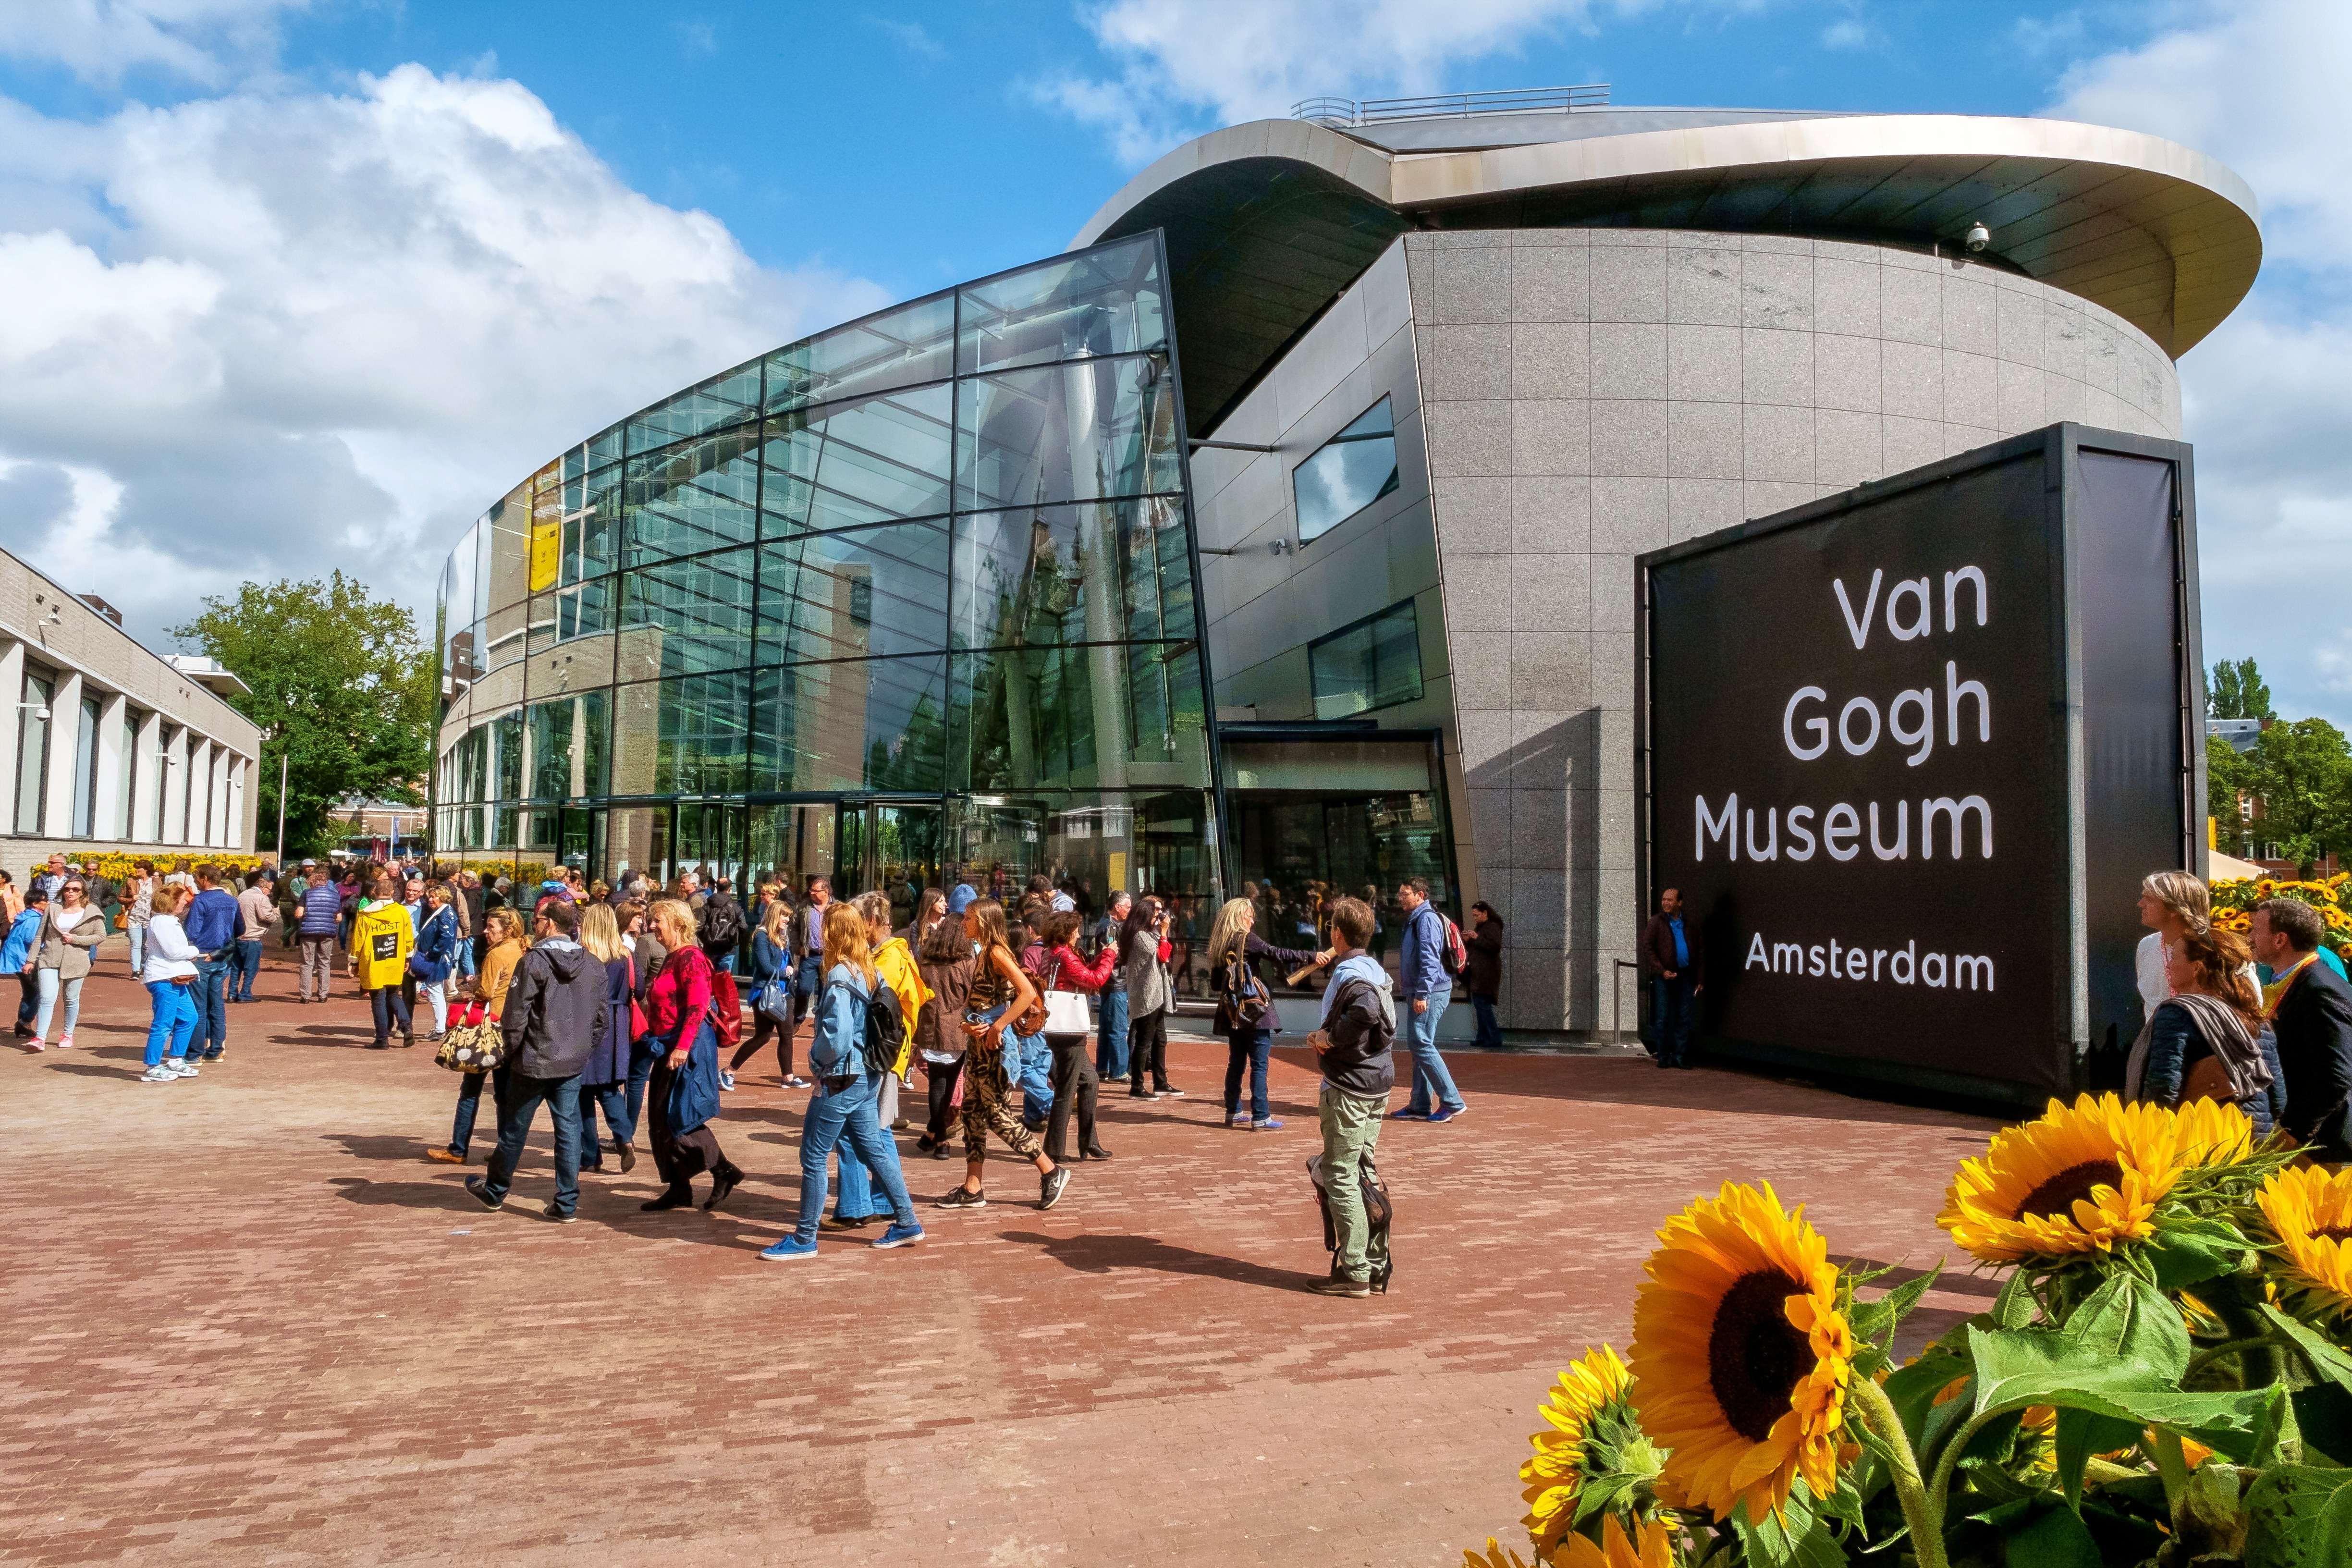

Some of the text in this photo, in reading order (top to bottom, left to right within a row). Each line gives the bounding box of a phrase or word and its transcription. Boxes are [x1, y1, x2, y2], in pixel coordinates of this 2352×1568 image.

[1833, 565, 1987, 649] Van
[1783, 660, 1990, 767] Gogh
[1696, 793, 1992, 862] Museum
[371, 921, 400, 932] HOST
[1745, 932, 1994, 992] Amsterdam
